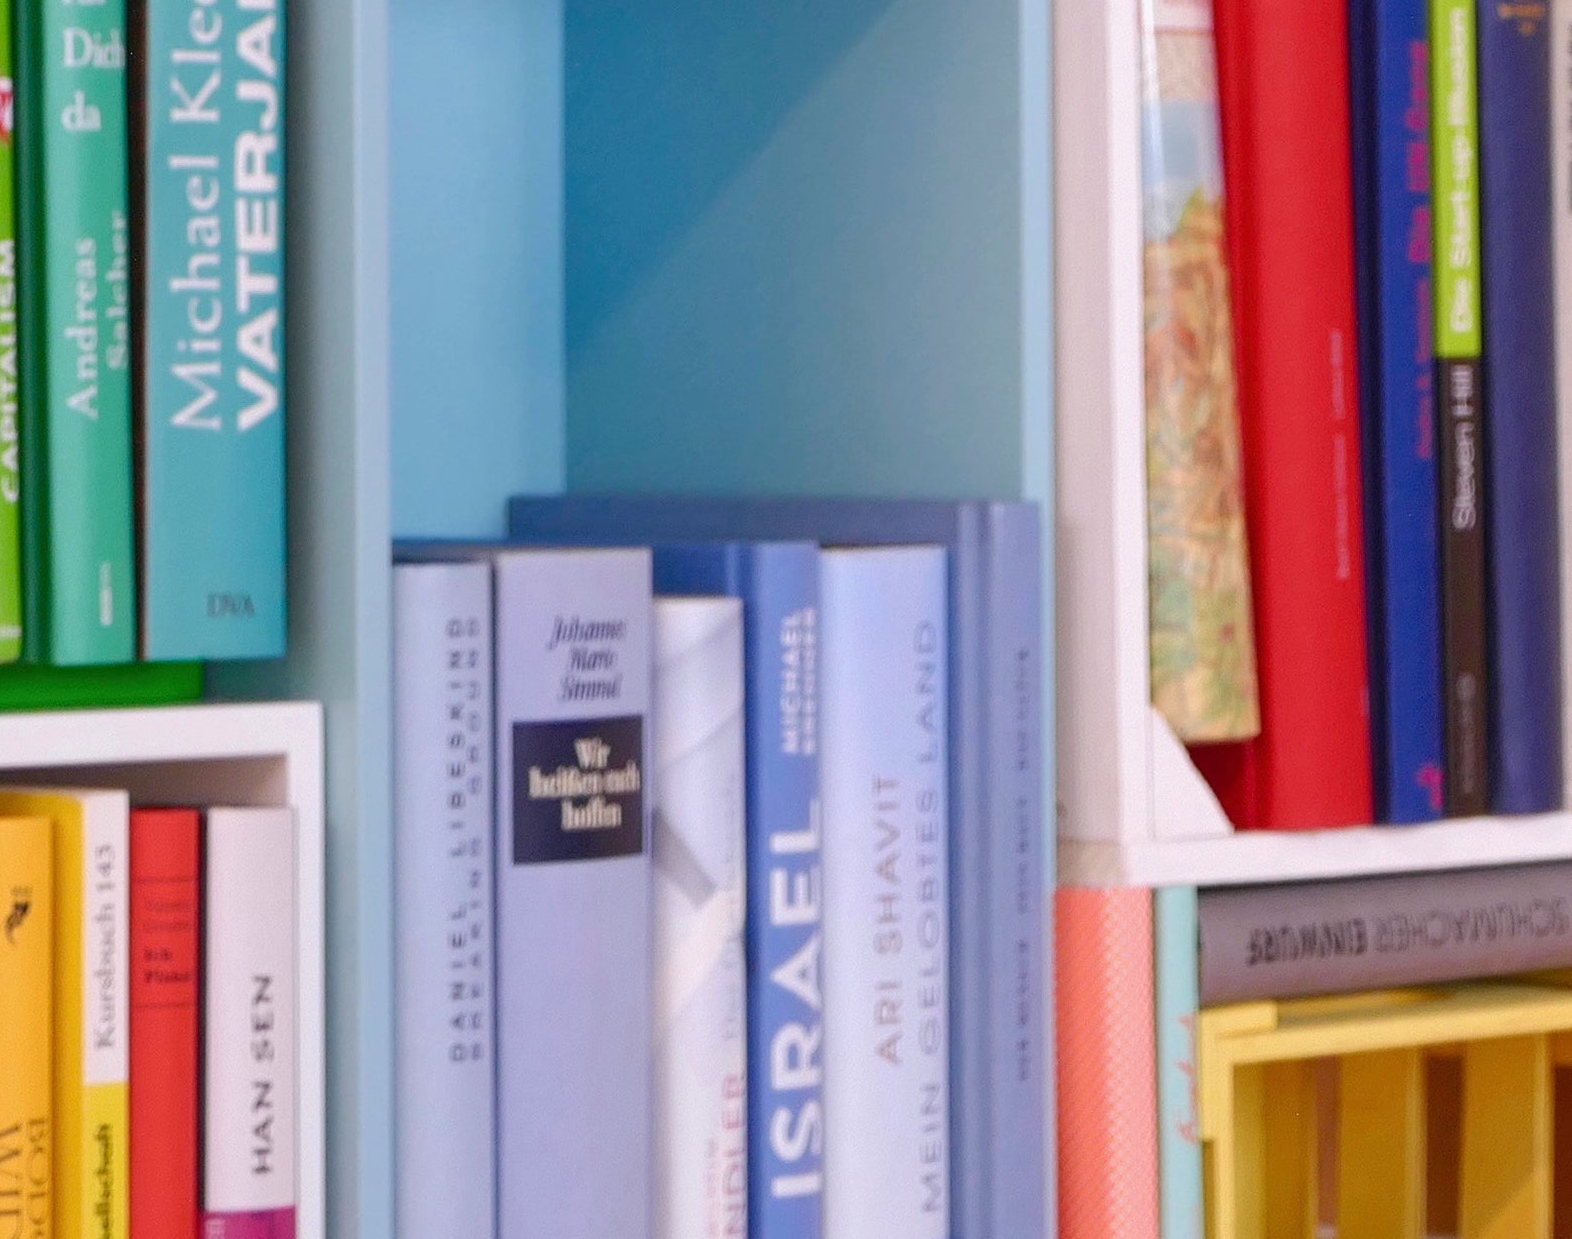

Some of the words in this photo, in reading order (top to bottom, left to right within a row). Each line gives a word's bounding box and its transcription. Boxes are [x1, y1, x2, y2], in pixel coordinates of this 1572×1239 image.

[60, 94, 102, 132] da
[62, 25, 126, 70] Dich
[65, 237, 100, 421] Andreas
[169, 153, 223, 432] Michael
[445, 617, 466, 858] LIBESKIND
[914, 620, 940, 764] LAND
[872, 772, 903, 957] SHAVIT
[915, 788, 943, 1056] GELOBTES
[94, 901, 116, 1052] Kursbuch
[769, 796, 822, 1198] ISRAEL
[873, 979, 903, 1068] ARI
[917, 1081, 944, 1215] MEIN
